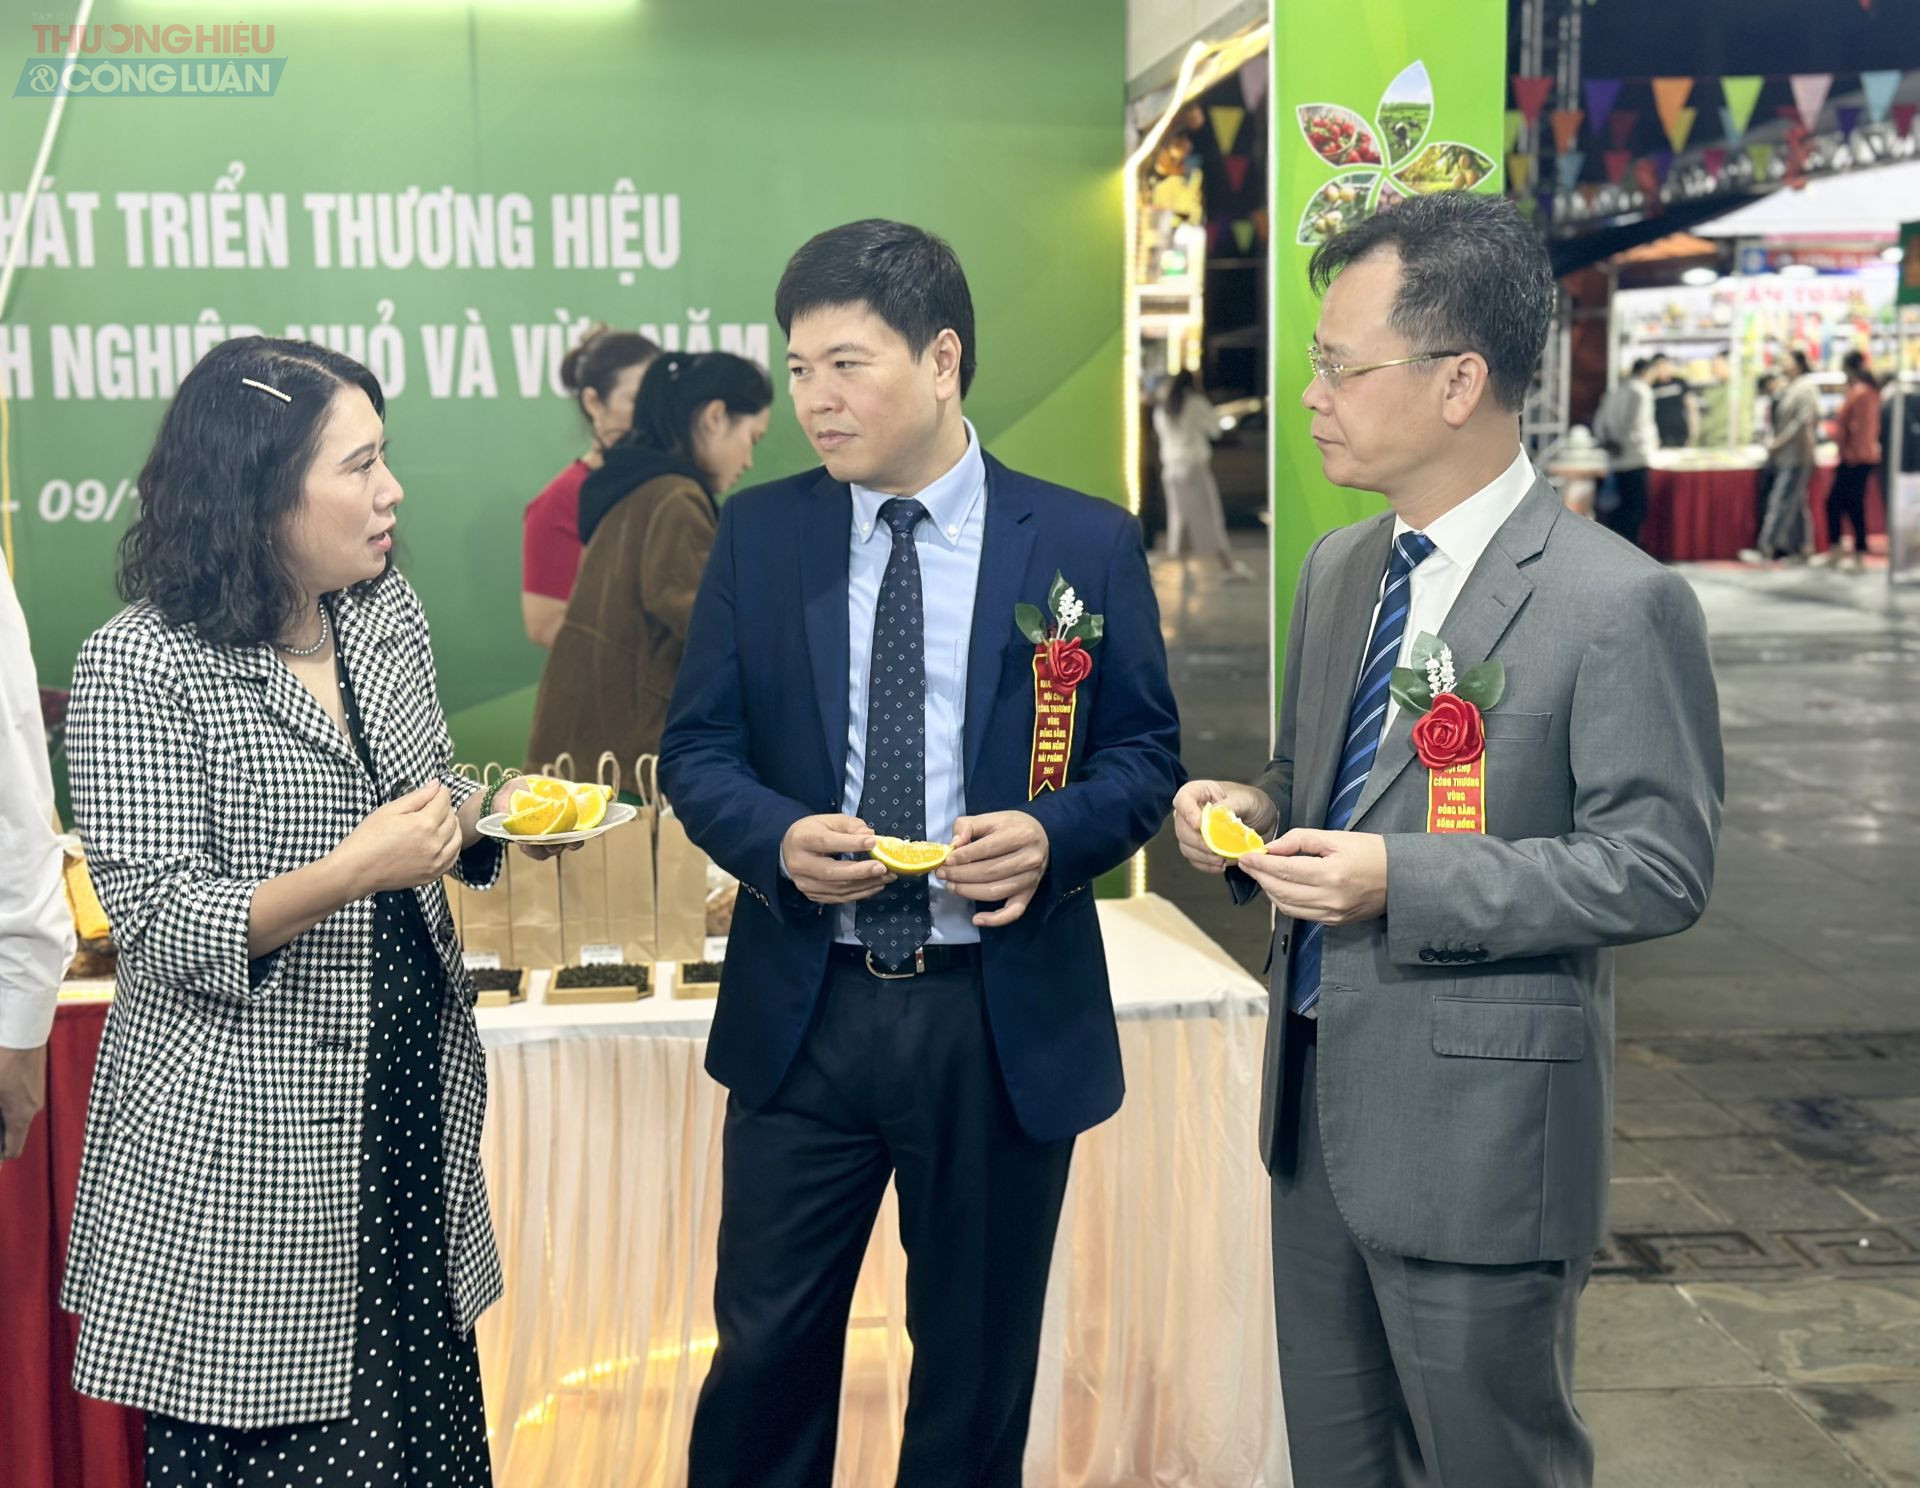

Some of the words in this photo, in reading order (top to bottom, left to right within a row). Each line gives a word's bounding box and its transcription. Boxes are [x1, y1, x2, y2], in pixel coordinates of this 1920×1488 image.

[116, 160, 289, 269] TRIỂN
[304, 185, 535, 269] THƯƠNG
[551, 177, 681, 286] HIỆU
[50, 308, 263, 400] NGHI
[420, 308, 498, 398] VÀ
